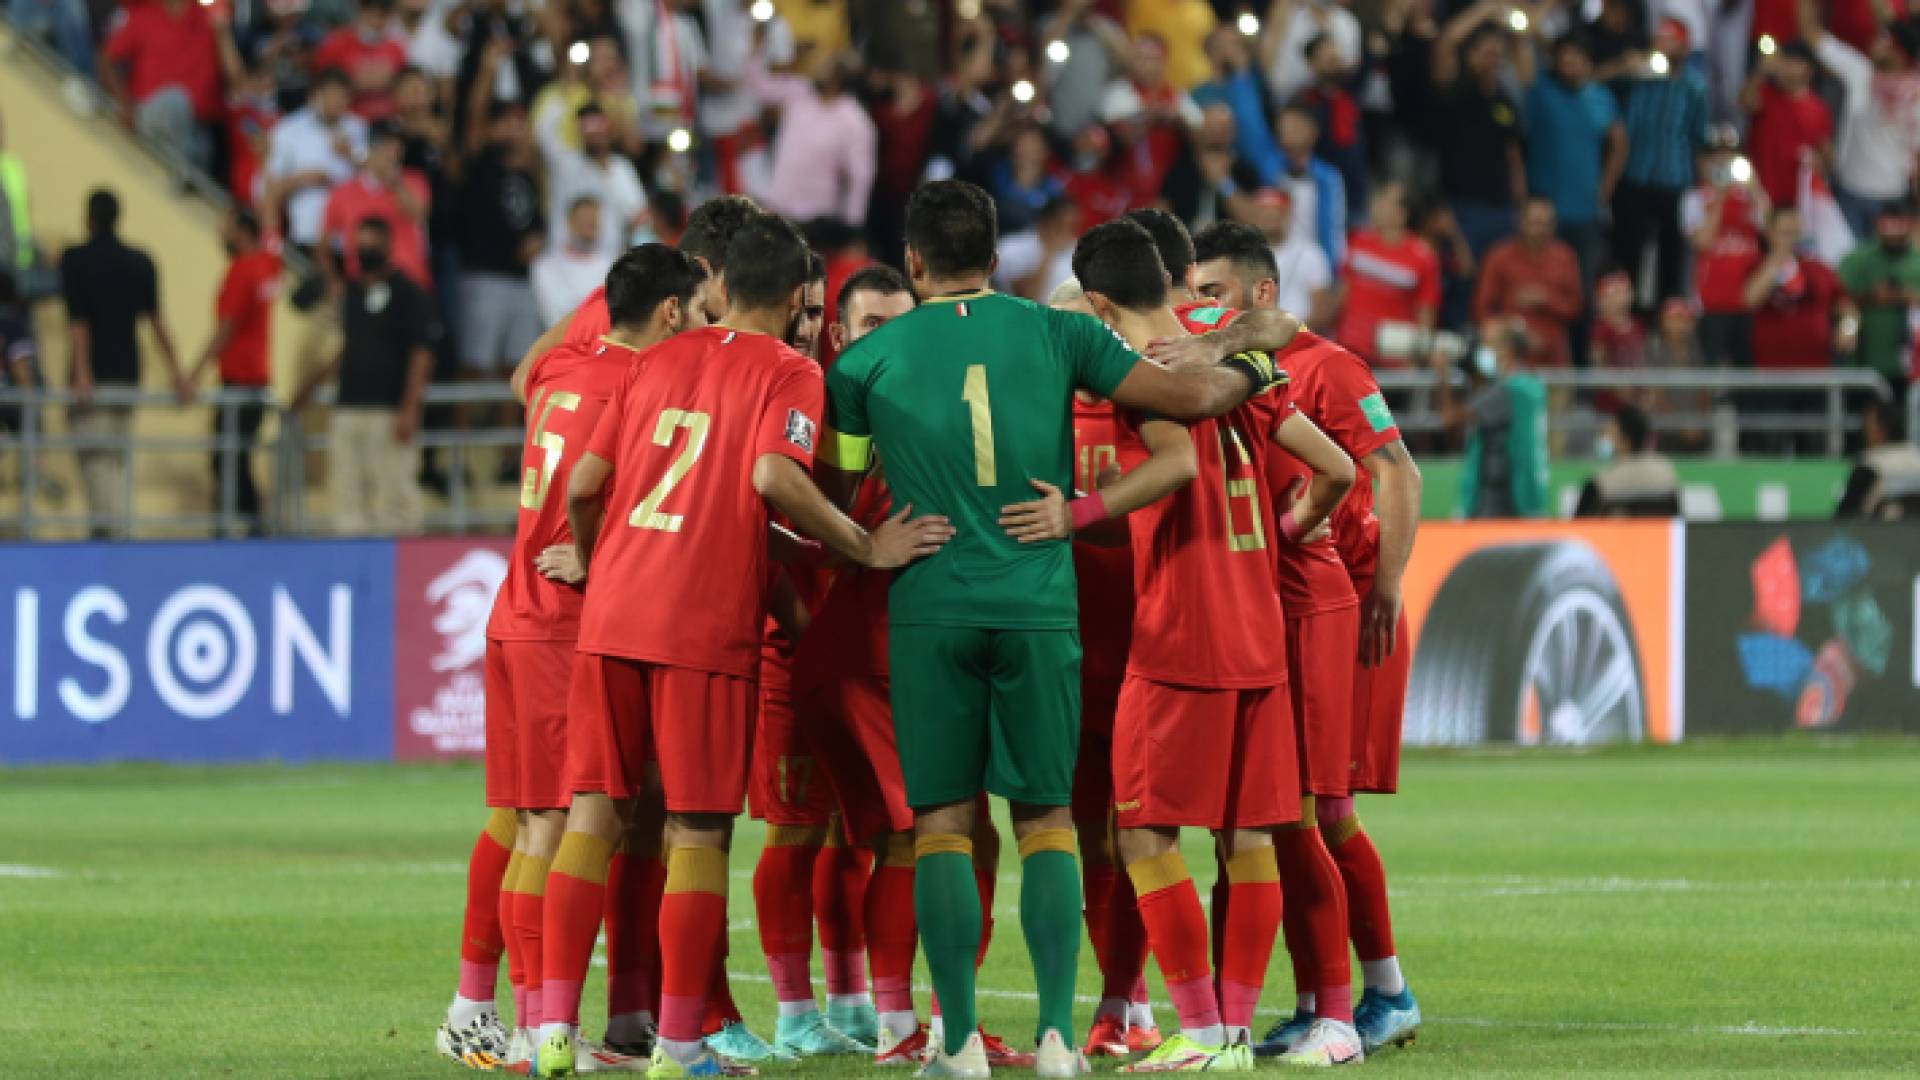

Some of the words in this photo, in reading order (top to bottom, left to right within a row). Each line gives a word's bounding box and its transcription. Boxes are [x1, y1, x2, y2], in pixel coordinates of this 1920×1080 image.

[629, 408, 711, 532] 2
[961, 364, 997, 486] 1
[13, 583, 352, 721] ISON
